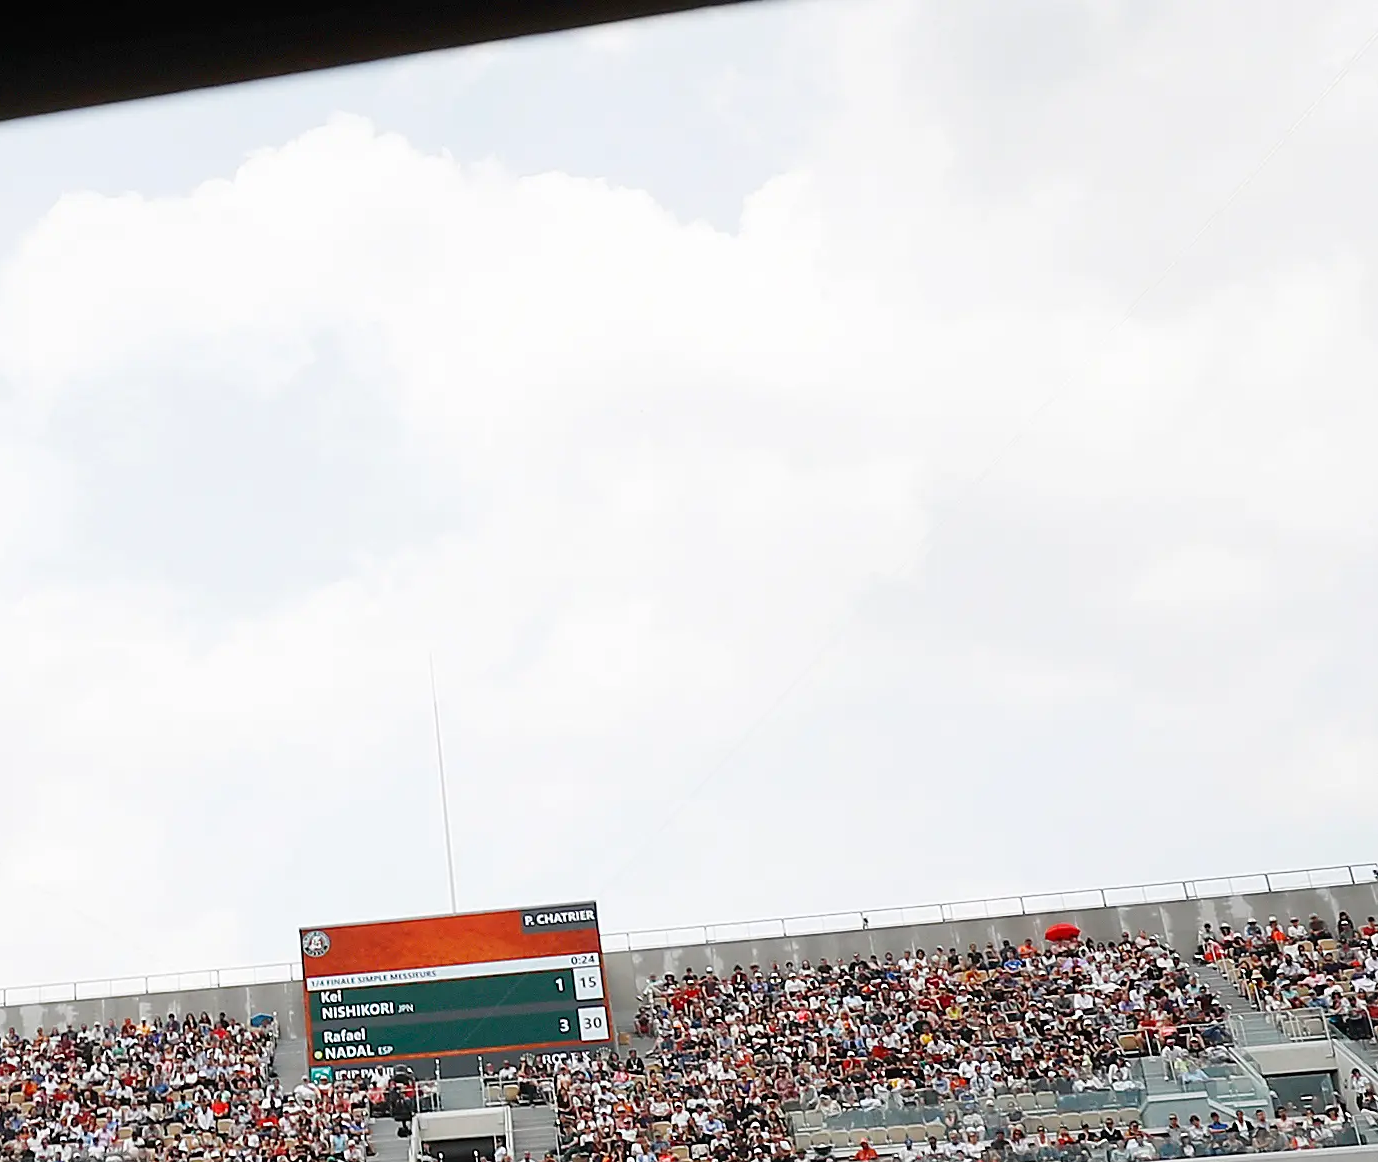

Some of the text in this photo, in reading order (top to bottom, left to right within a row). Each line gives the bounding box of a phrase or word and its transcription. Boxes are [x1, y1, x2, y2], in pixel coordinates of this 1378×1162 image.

[524, 909, 595, 926] P. CHATRIER
[570, 955, 595, 966] 0:24
[326, 976, 355, 986] FINALE
[357, 974, 387, 984] SIMPLE
[390, 970, 437, 981] MESSIEURS
[555, 978, 565, 992] 1
[580, 977, 597, 988] 15
[320, 989, 342, 1004] Kei
[322, 1001, 415, 1020] NISHIKORI JPN
[559, 1019, 571, 1033] 3
[584, 1018, 602, 1029] 30
[323, 1028, 366, 1044] Rafael
[324, 1043, 394, 1060] NADAL ESP
